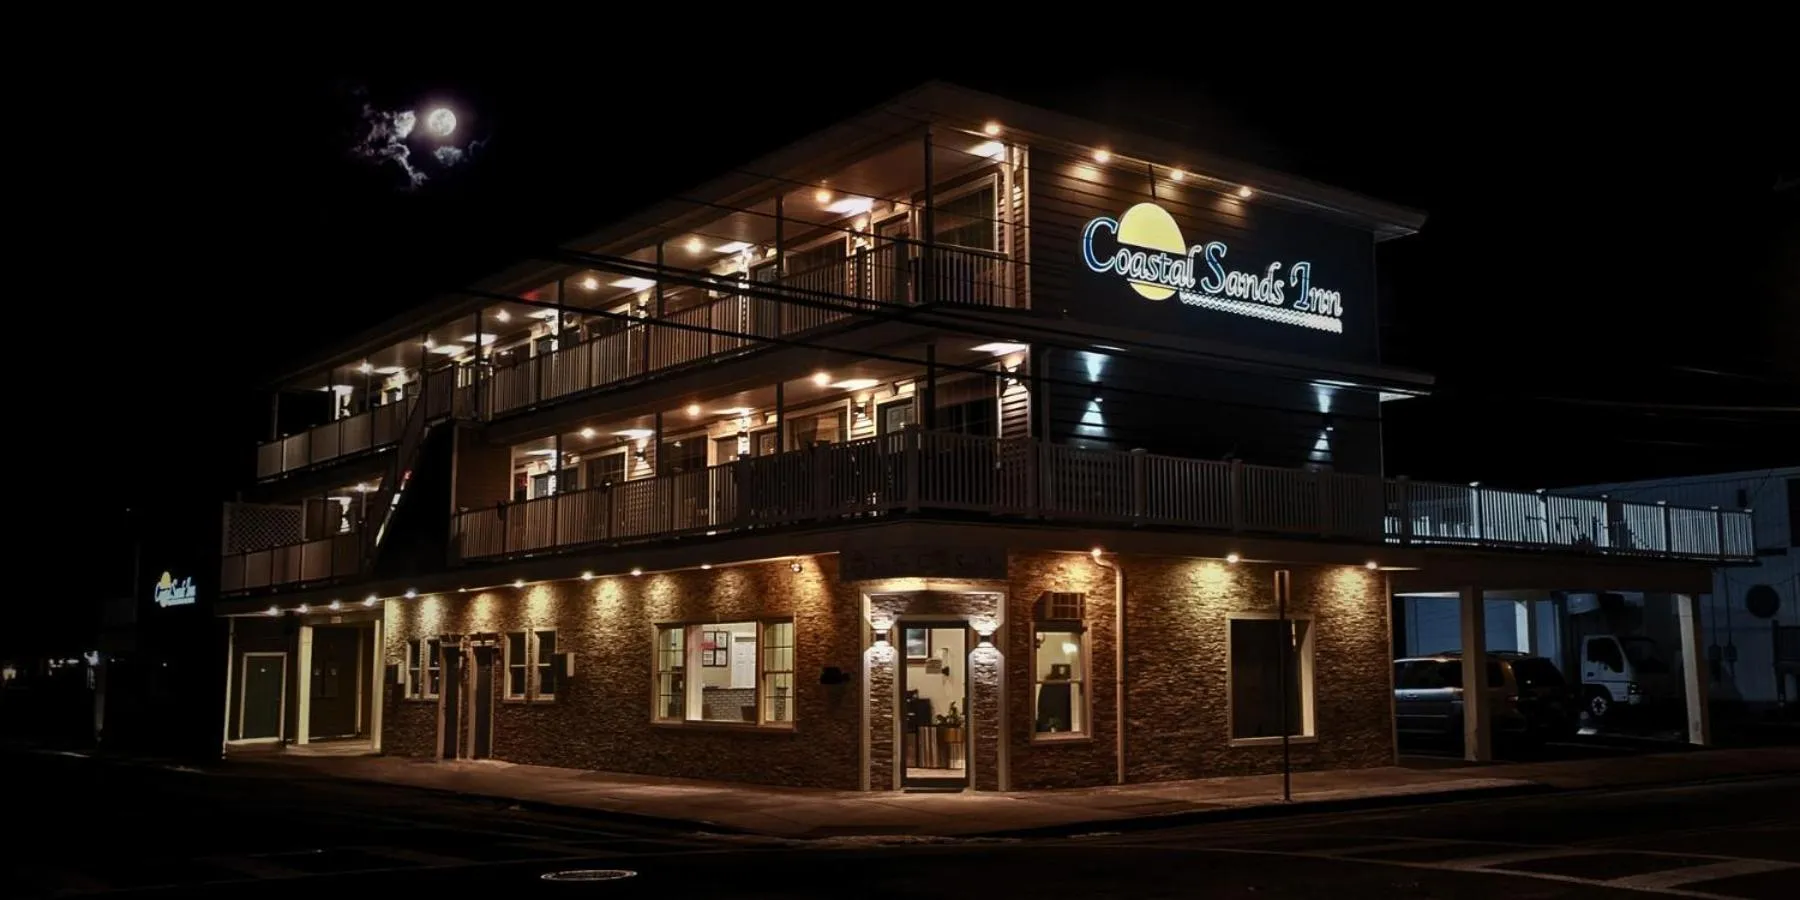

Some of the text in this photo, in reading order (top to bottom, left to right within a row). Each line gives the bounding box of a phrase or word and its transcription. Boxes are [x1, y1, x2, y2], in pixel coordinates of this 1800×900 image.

[1083, 217, 1343, 316] Coastal Sands Inn
